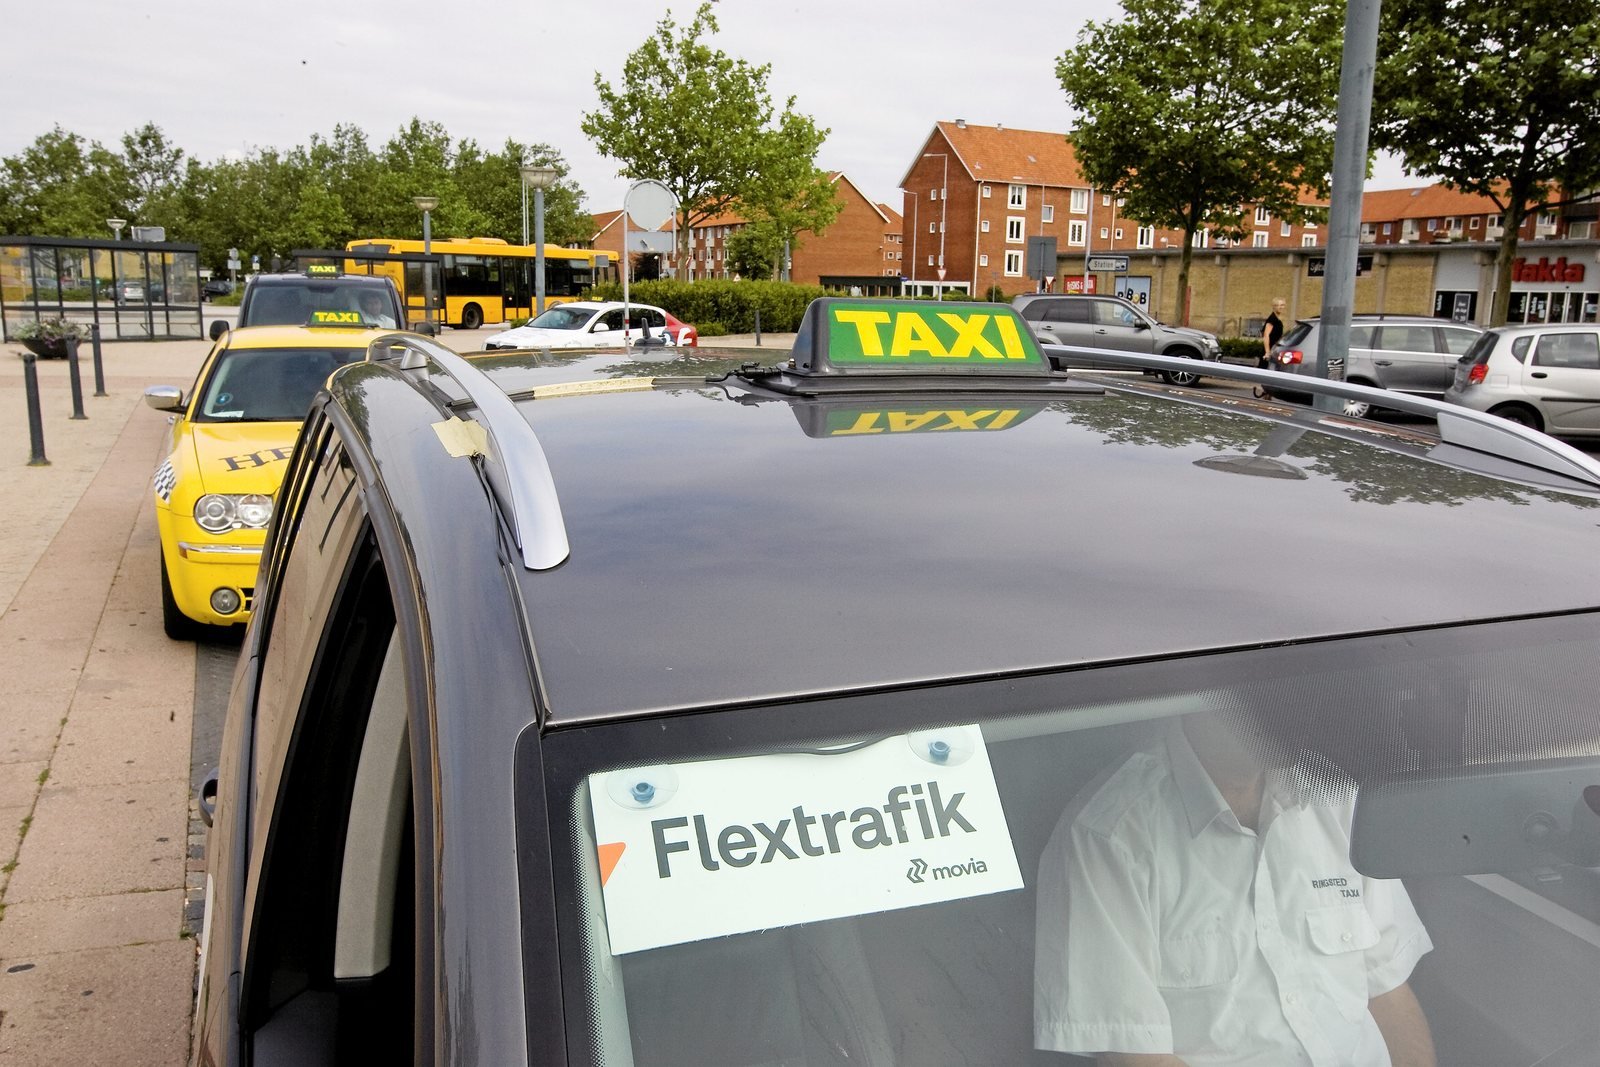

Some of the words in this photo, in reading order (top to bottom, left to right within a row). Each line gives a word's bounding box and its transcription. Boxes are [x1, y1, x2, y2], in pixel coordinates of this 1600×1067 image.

[310, 265, 336, 273] TAXI
[1511, 256, 1585, 282] fakta
[314, 312, 359, 323] TAXI
[834, 311, 1026, 359] TAXI
[651, 781, 977, 879] Flextrafik
[932, 858, 988, 880] movia
[1312, 878, 1347, 888] RINGSTED
